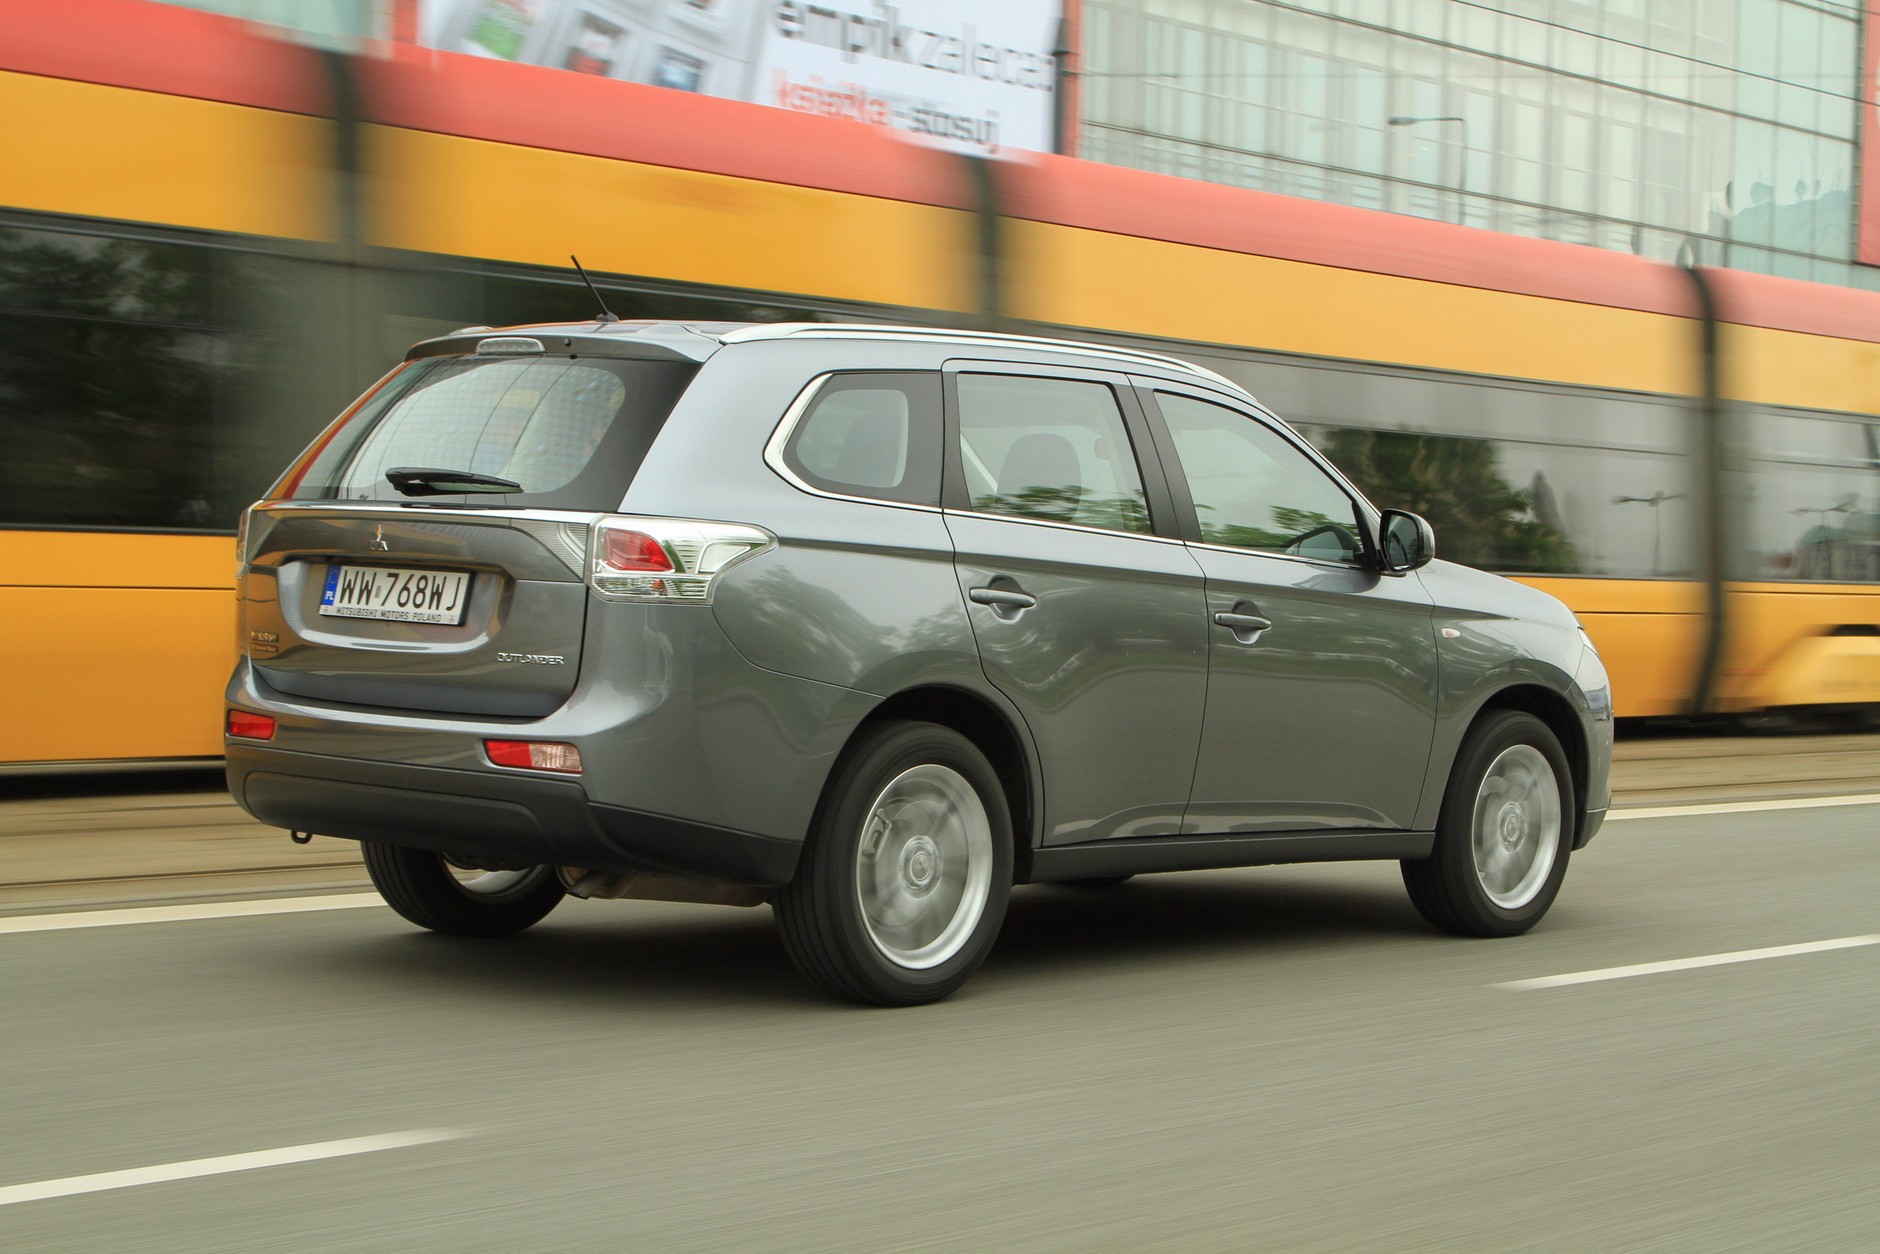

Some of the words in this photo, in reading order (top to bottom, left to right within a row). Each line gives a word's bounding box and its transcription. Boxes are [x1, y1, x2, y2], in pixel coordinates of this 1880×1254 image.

[325, 590, 334, 600] PL
[336, 606, 377, 618] MITSUBISHI
[381, 611, 409, 620] MOTORS
[413, 613, 442, 623] POLAND
[497, 652, 564, 665] OUTLANDER
